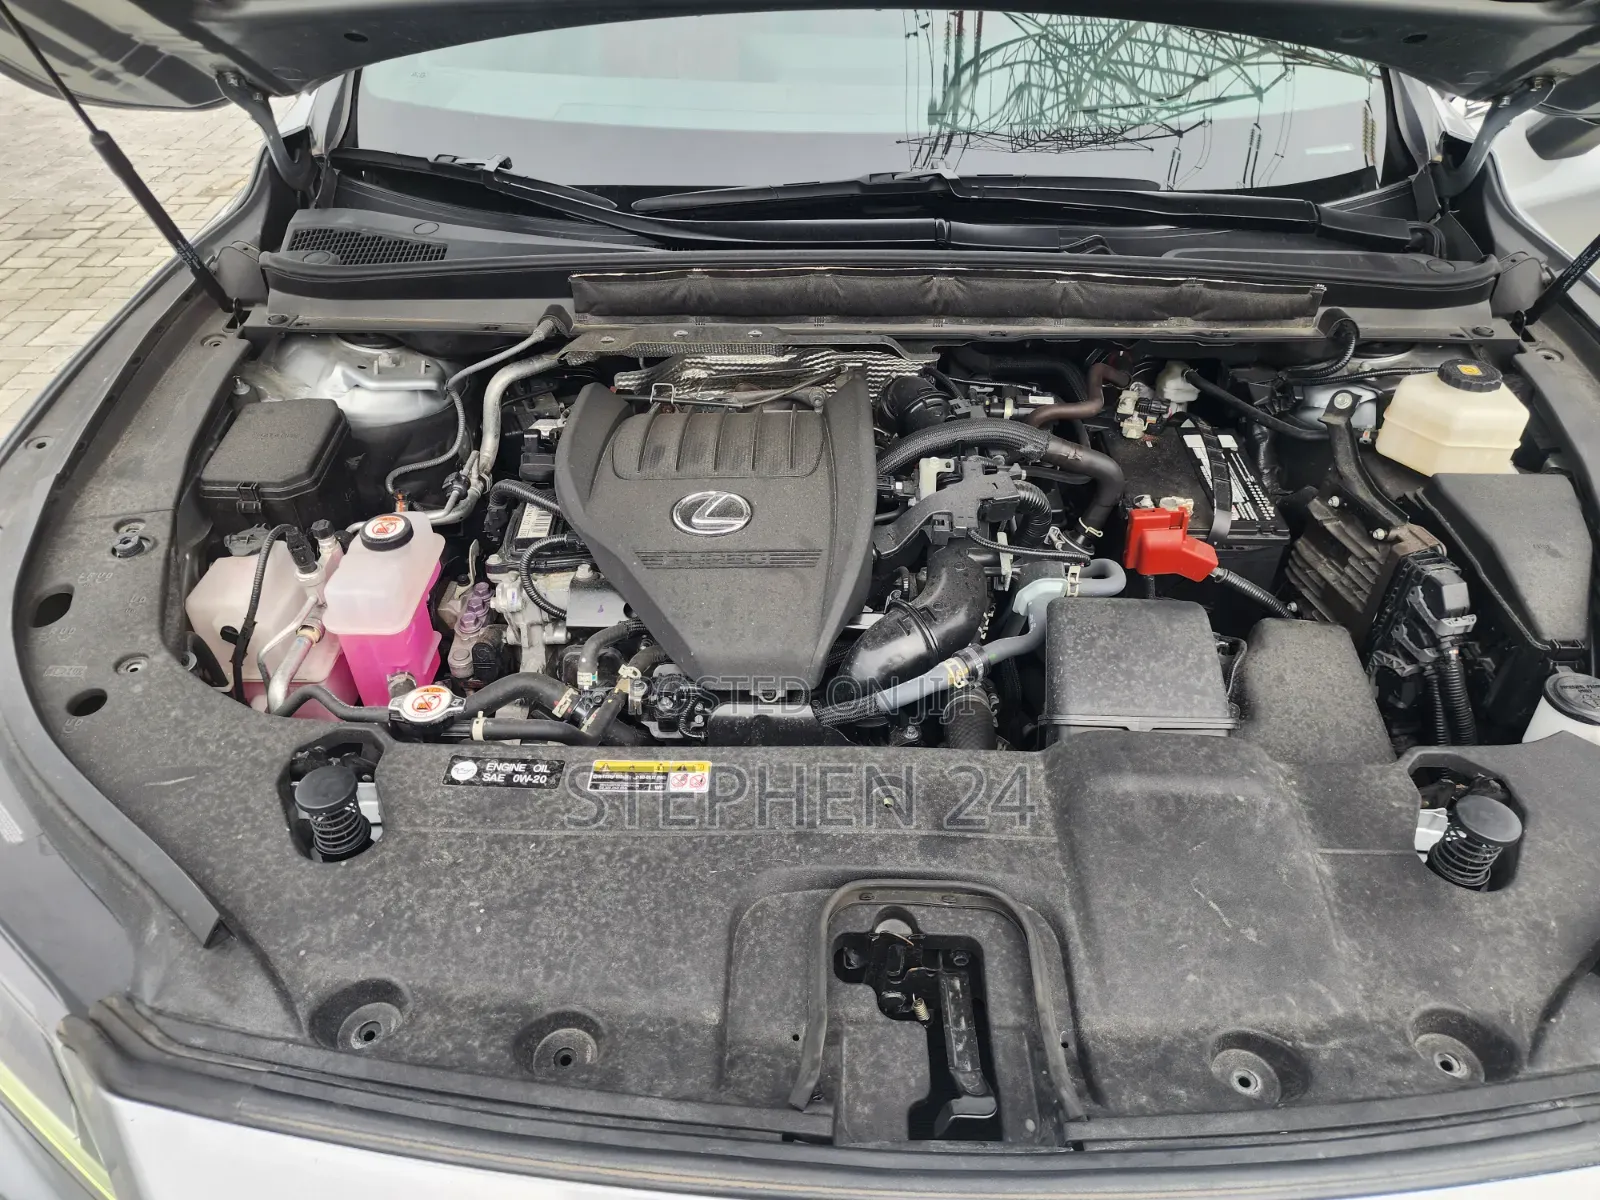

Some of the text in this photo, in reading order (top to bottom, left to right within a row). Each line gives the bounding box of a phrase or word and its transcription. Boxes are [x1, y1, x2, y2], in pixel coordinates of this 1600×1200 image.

[485, 762, 551, 773] ENGINE OIL
[482, 773, 548, 784] SAE 0W-20
